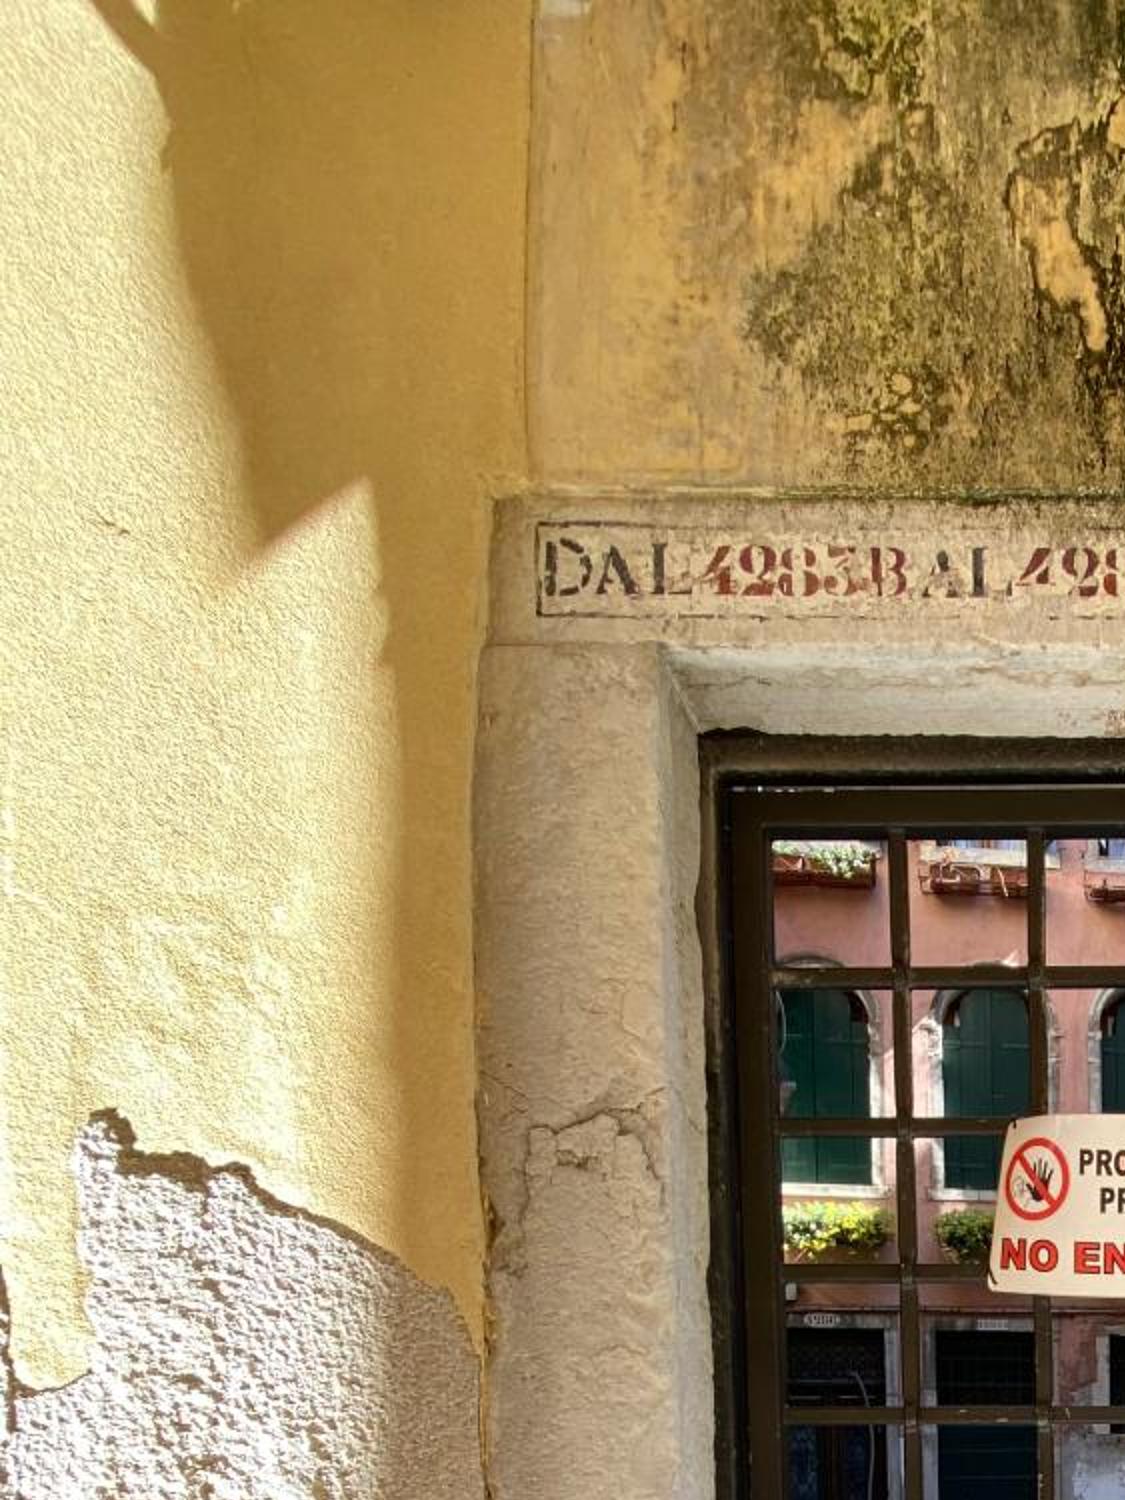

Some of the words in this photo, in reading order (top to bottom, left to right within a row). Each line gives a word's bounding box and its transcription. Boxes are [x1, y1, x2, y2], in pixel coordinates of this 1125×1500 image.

[544, 537, 693, 597] DAL
[921, 546, 1013, 598] AL
[1000, 1238, 1059, 1273] NO
